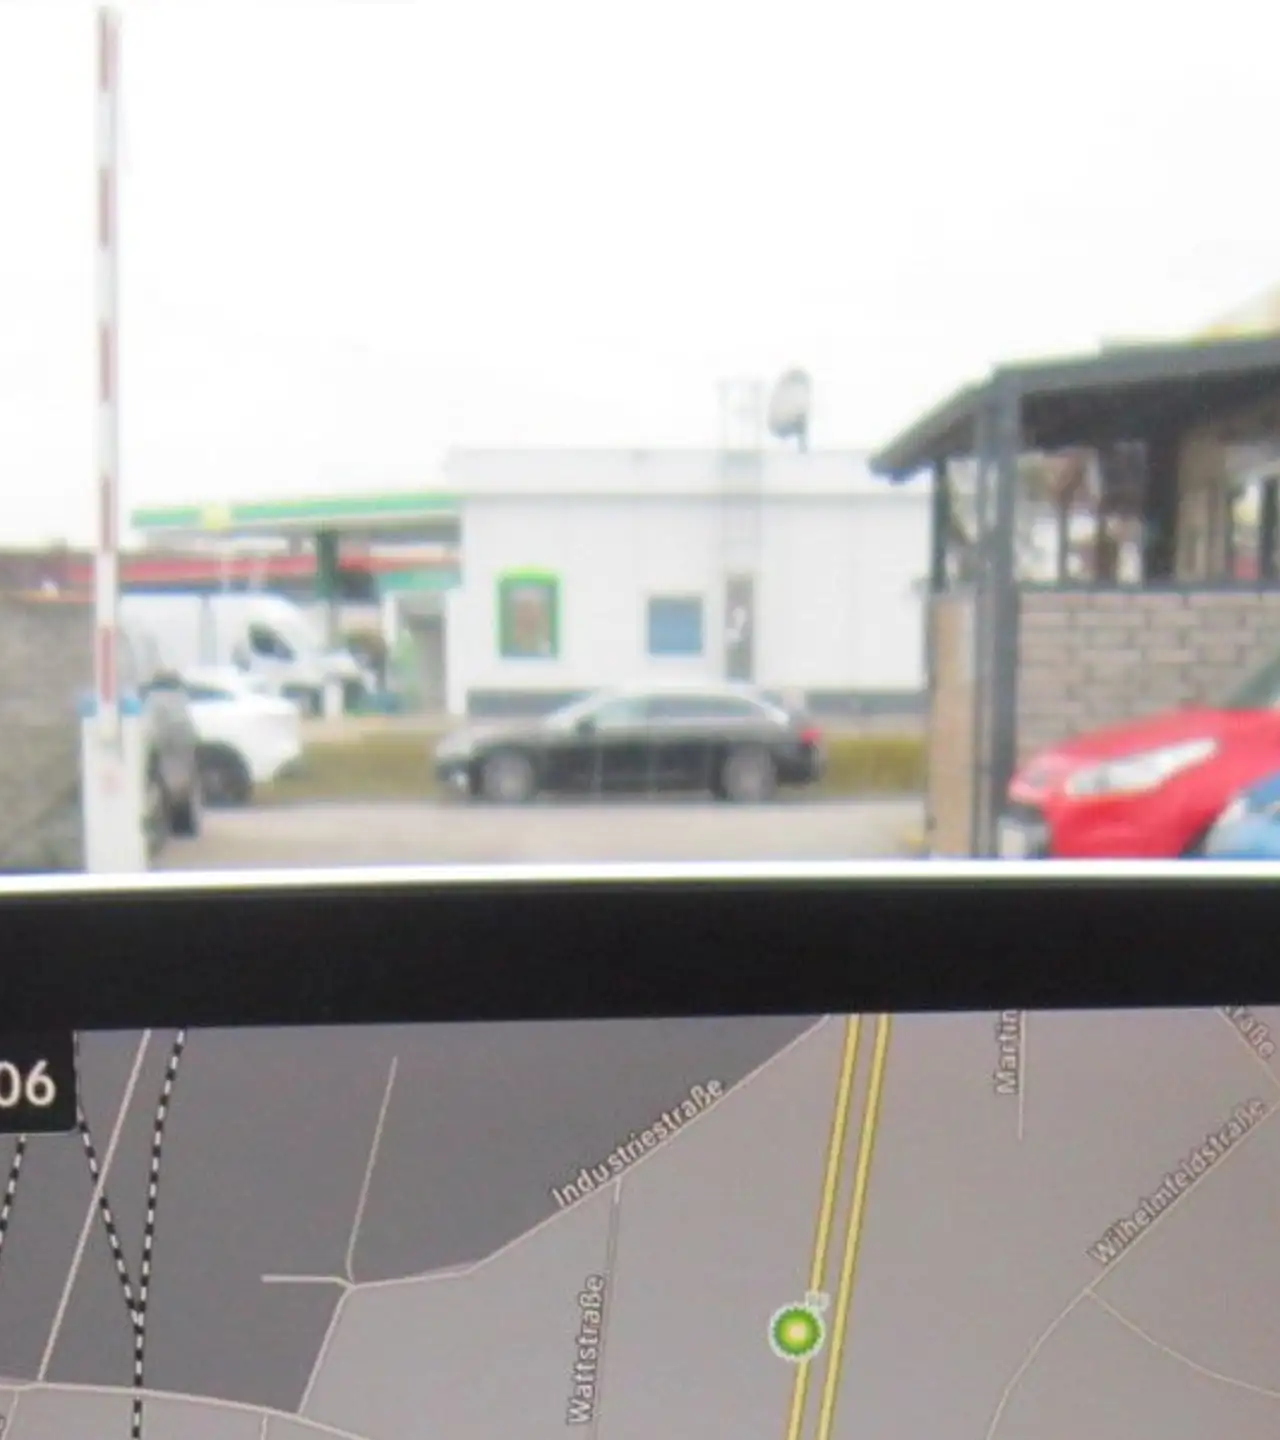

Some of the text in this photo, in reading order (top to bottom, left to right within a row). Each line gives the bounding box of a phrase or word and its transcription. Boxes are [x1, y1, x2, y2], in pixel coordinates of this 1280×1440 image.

[995, 1007, 1019, 1095] Martin
[551, 1078, 723, 1208] Industriestraße
[1090, 1098, 1267, 1266] Wilhelmfeldstraße
[566, 1274, 606, 1426] Wattstraße
